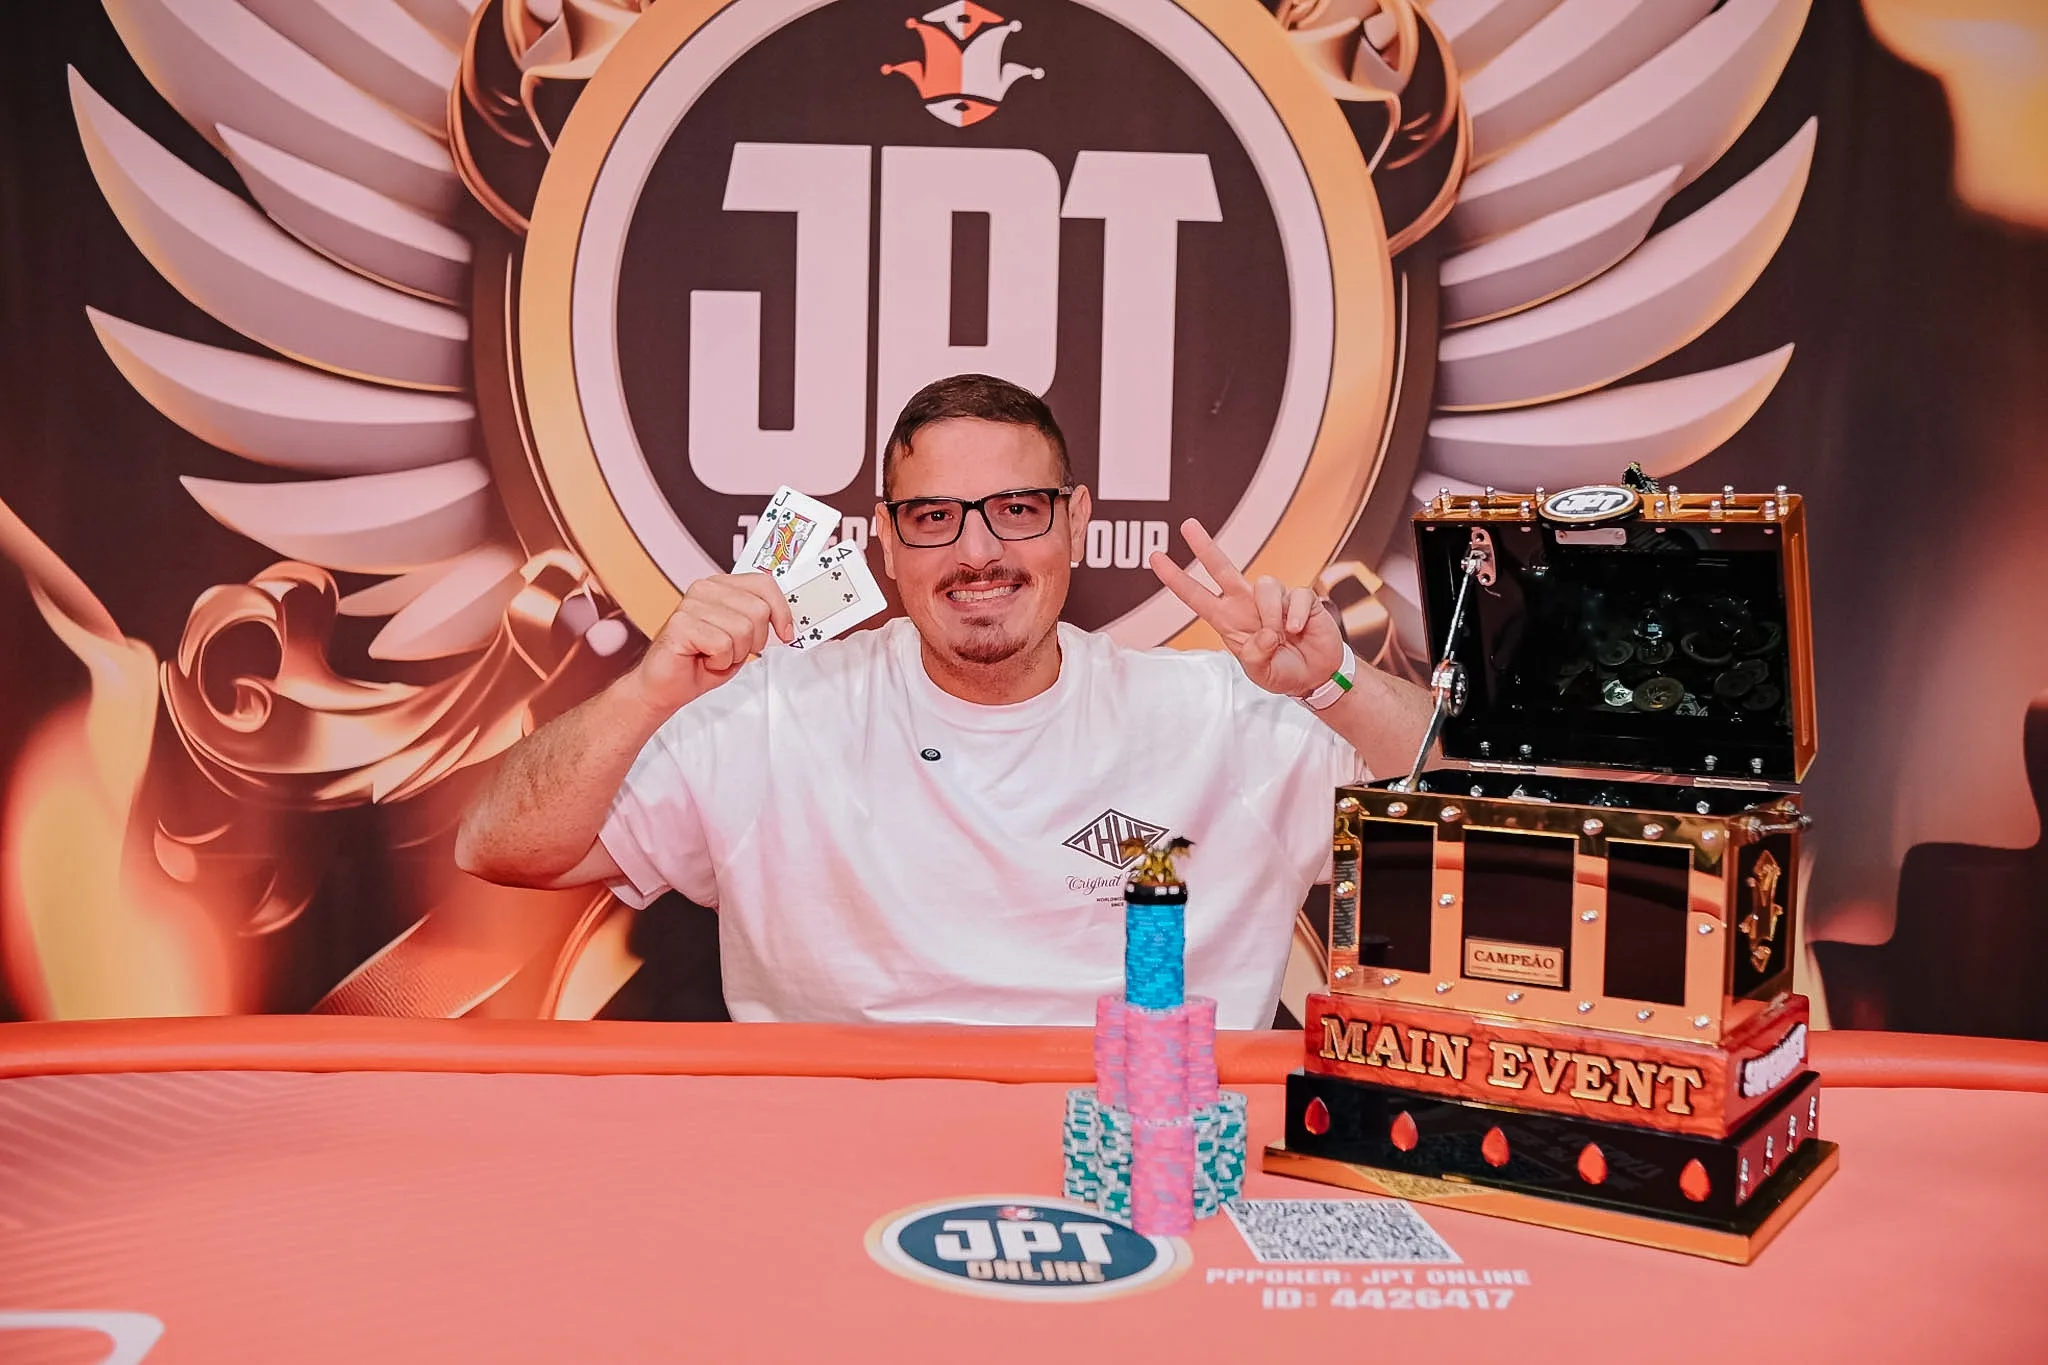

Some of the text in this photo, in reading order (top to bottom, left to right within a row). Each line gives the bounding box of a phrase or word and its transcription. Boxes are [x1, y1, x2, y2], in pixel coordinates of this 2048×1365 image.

[688, 142, 1223, 502] JPT
[774, 491, 791, 506] J
[1555, 493, 1624, 512] JPT
[1085, 519, 1170, 569] OUR
[1065, 874, 1123, 896] Original
[1474, 950, 1555, 970] CAMPEÃO
[1319, 1016, 1469, 1080] MAIN
[1487, 1039, 1704, 1115] EVENT
[934, 1219, 1114, 1265] JPT
[966, 1259, 1106, 1284] ONLINE
[1361, 1269, 1416, 1286] JPT
[1426, 1269, 1532, 1286] ONLINE
[1262, 1287, 1514, 1310] ID: 4426417
